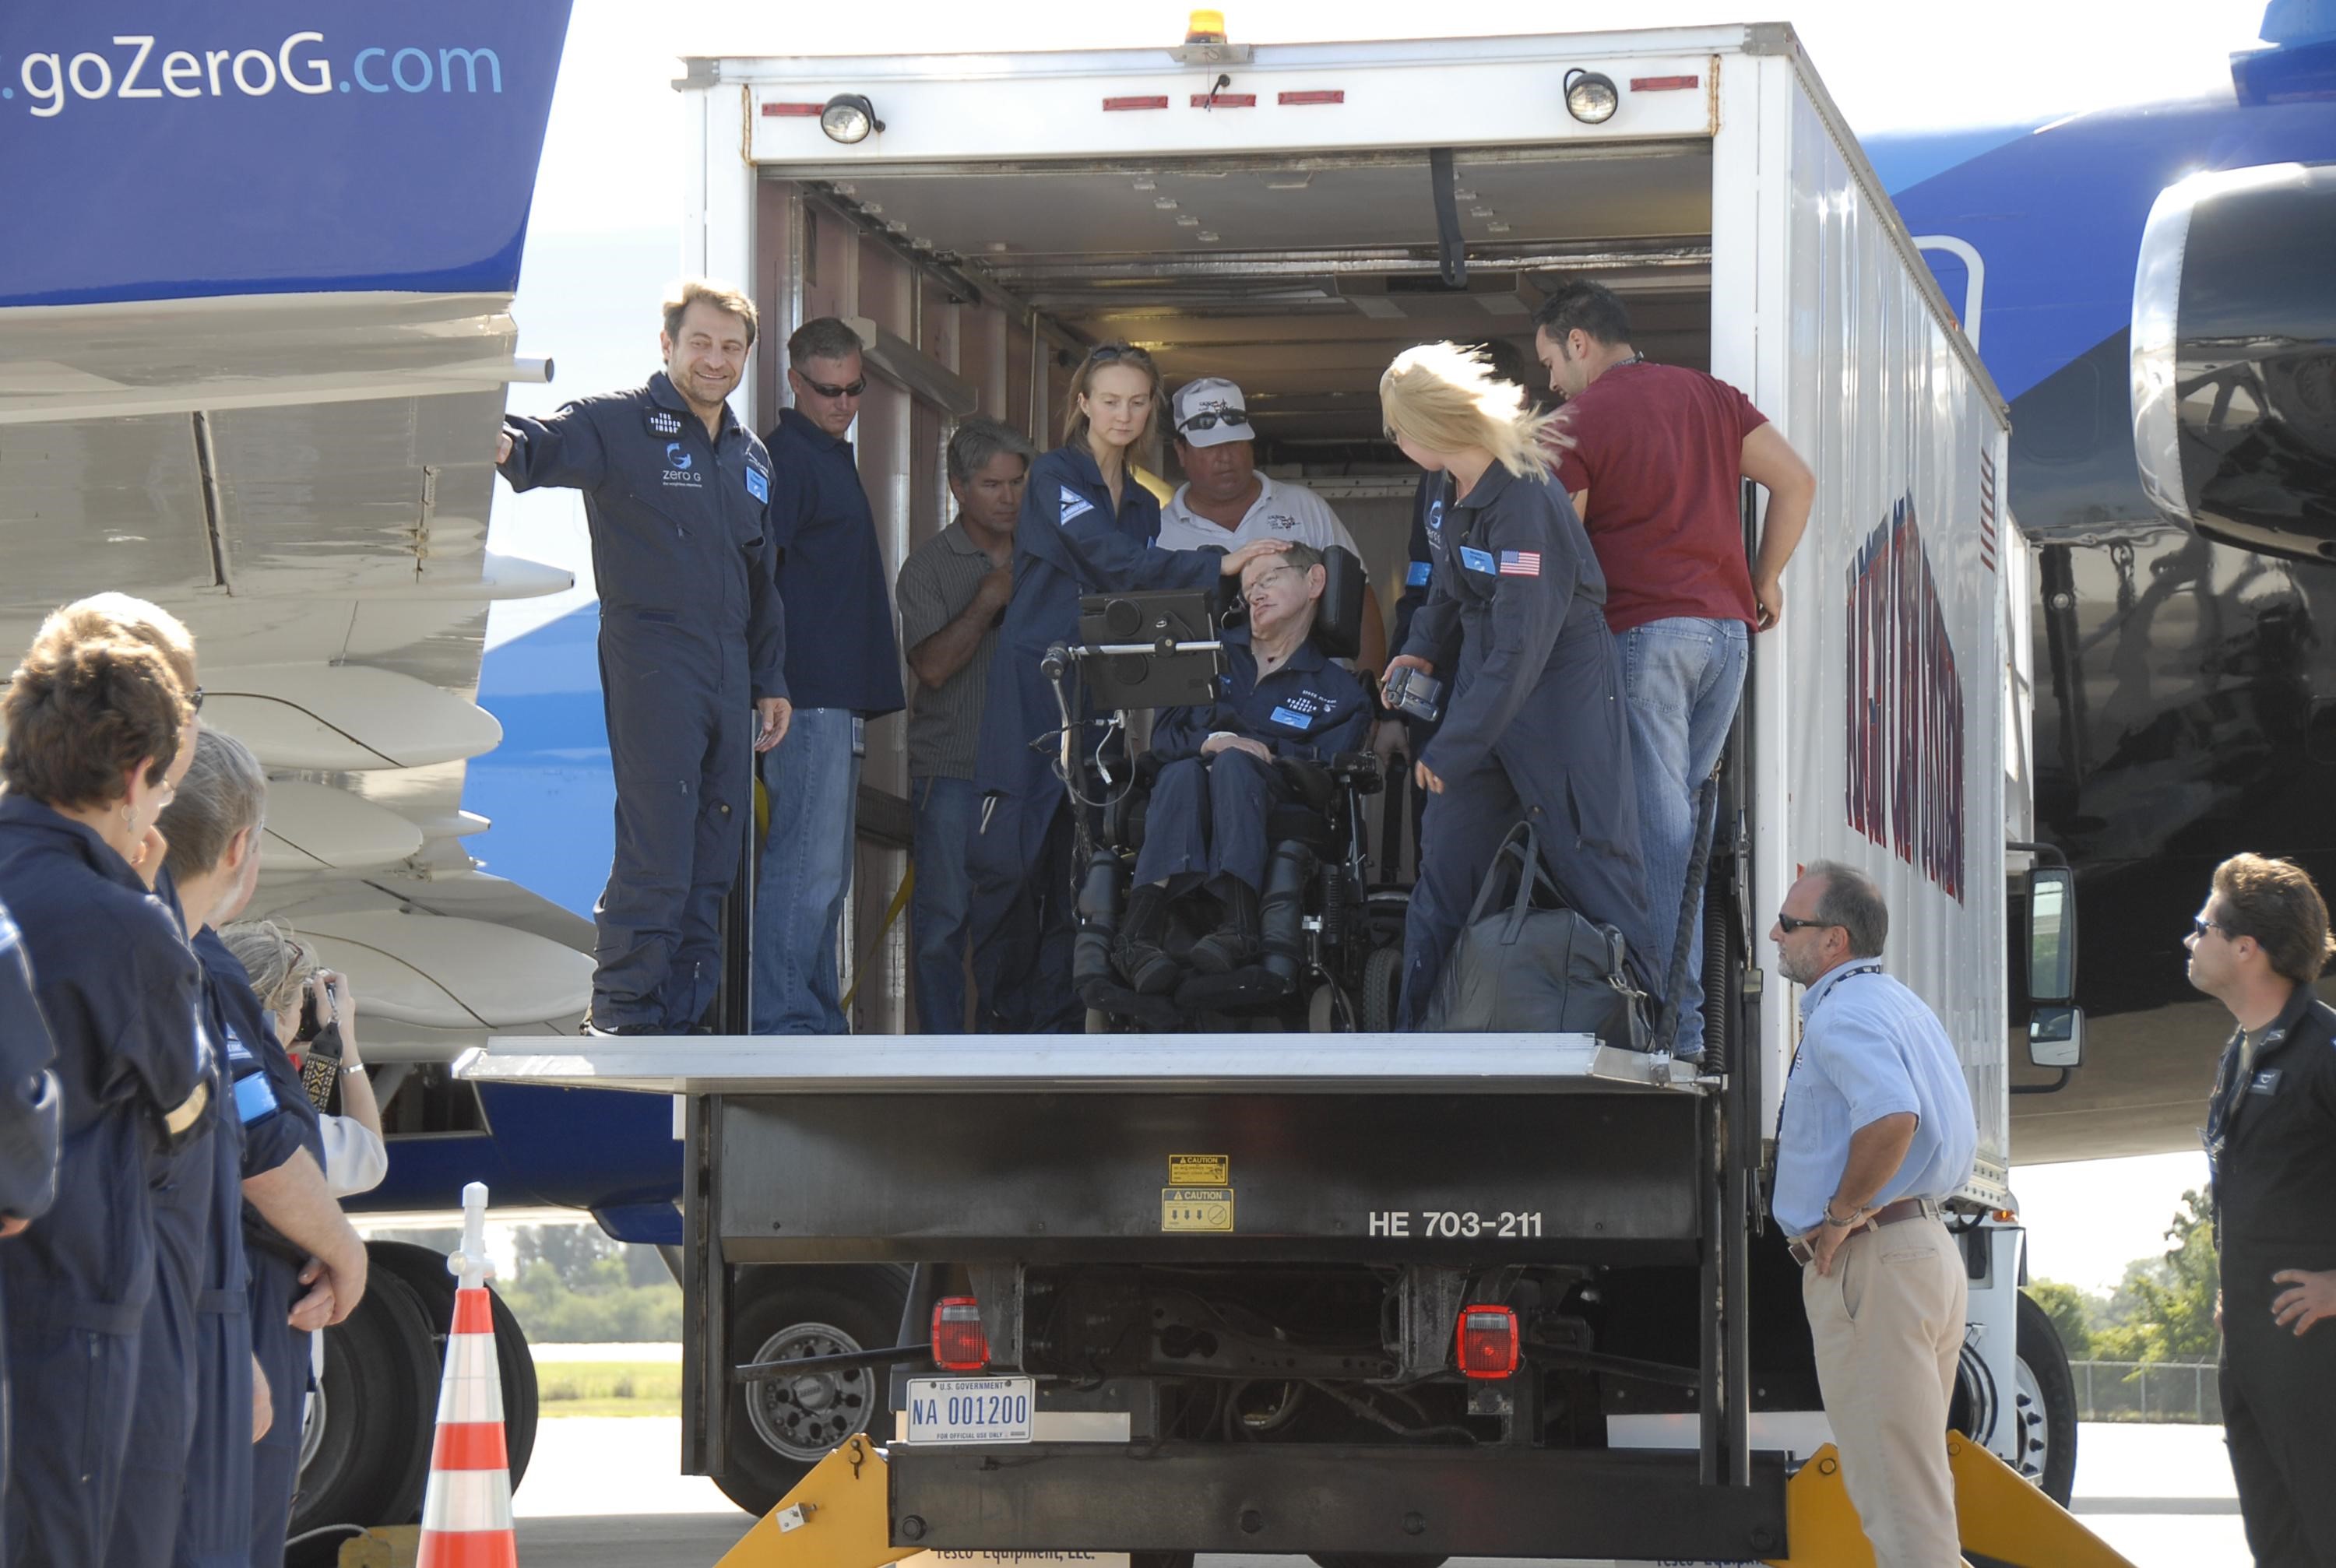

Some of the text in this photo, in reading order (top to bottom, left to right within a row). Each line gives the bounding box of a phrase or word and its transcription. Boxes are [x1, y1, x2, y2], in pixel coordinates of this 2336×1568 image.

[663, 470, 702, 481] zero G
[1184, 1191, 1223, 1200] CAUTION
[1369, 1211, 1541, 1237] HE 703-211
[955, 1382, 1004, 1390] GOVERNMENT
[913, 1395, 1026, 1426] NA 001200
